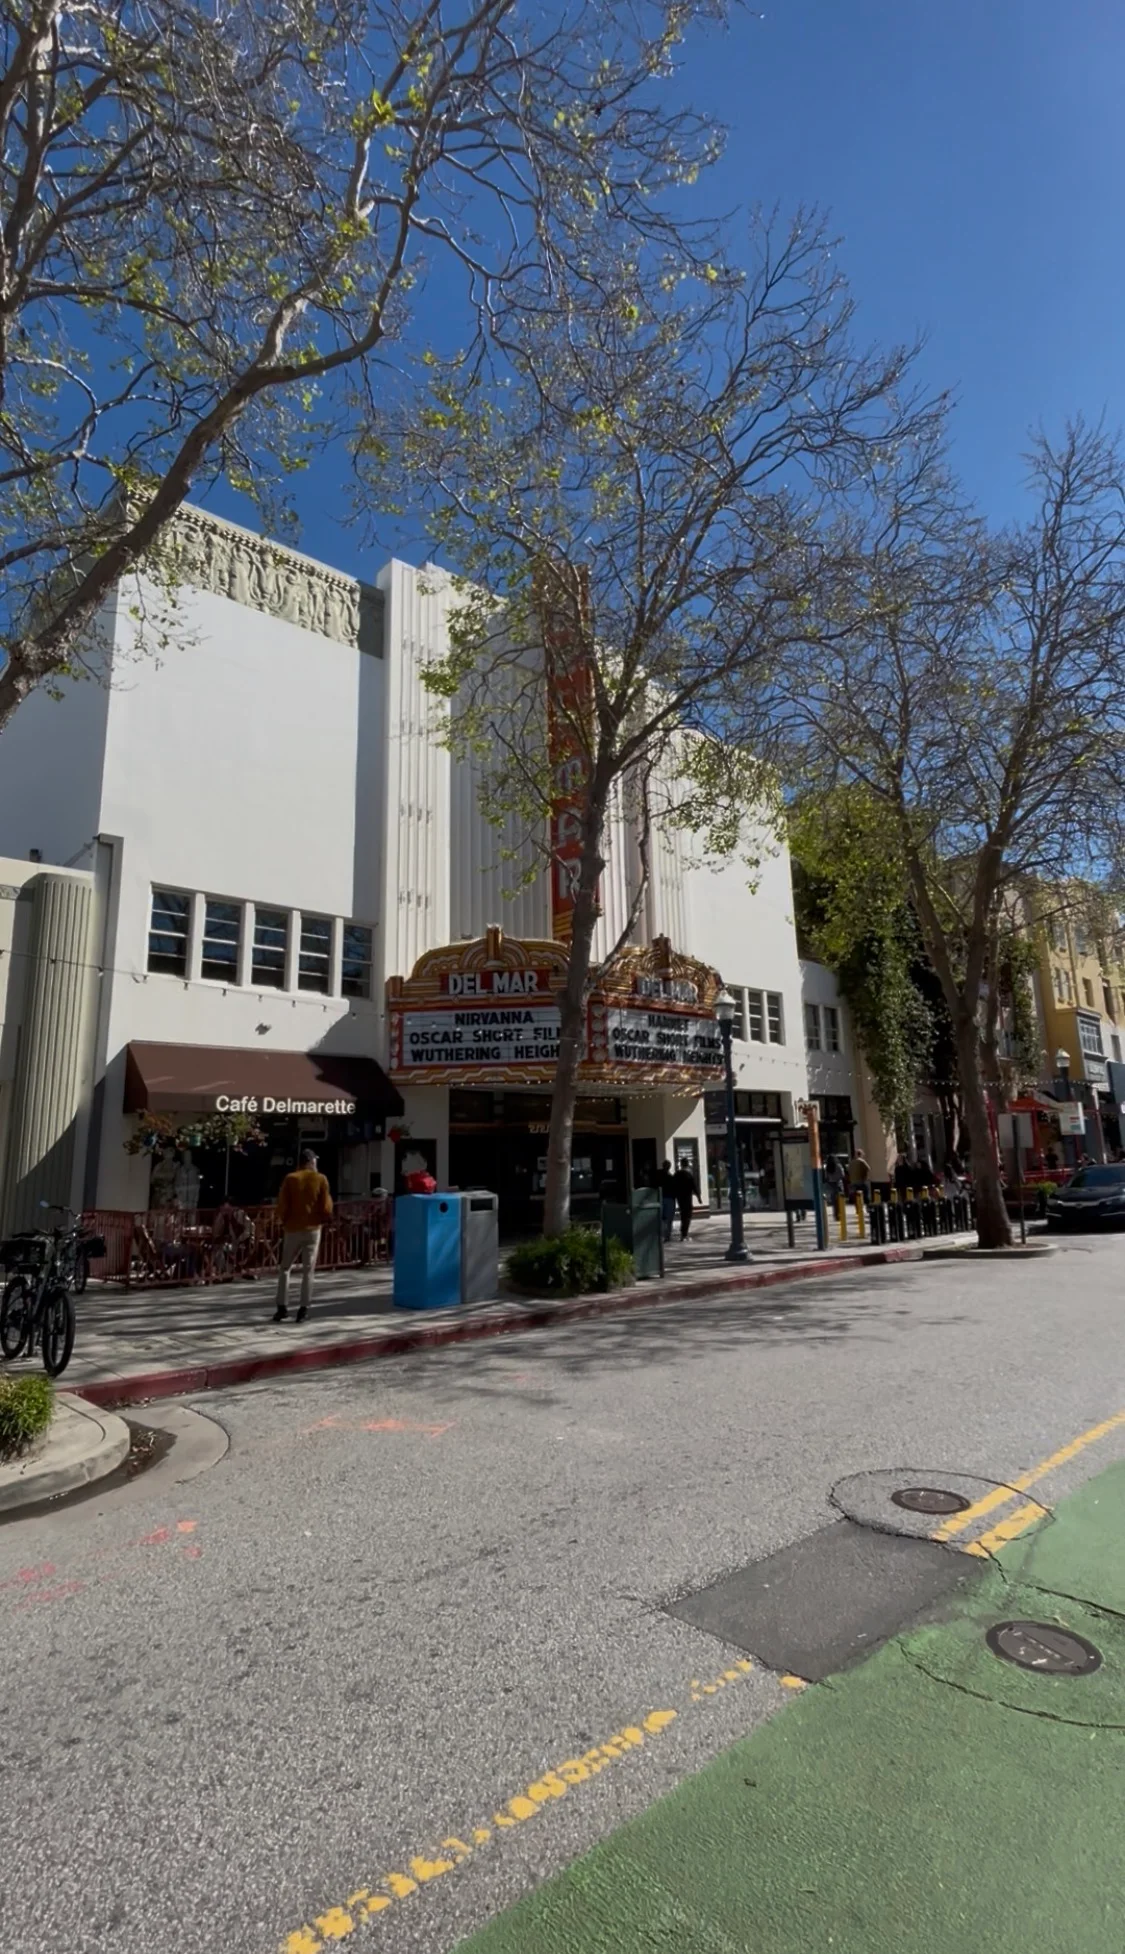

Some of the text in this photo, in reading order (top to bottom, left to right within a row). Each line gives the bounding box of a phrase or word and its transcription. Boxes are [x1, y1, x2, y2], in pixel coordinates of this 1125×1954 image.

[448, 970, 539, 995] DEL MAR
[455, 1010, 535, 1026] NIRVANNA
[409, 1026, 561, 1045] OSCAR SHORT FIL
[612, 1027, 650, 1042] OSCAR
[410, 1044, 560, 1062] WUTHERING HEIGH
[215, 1094, 356, 1114] Café Delmarette
